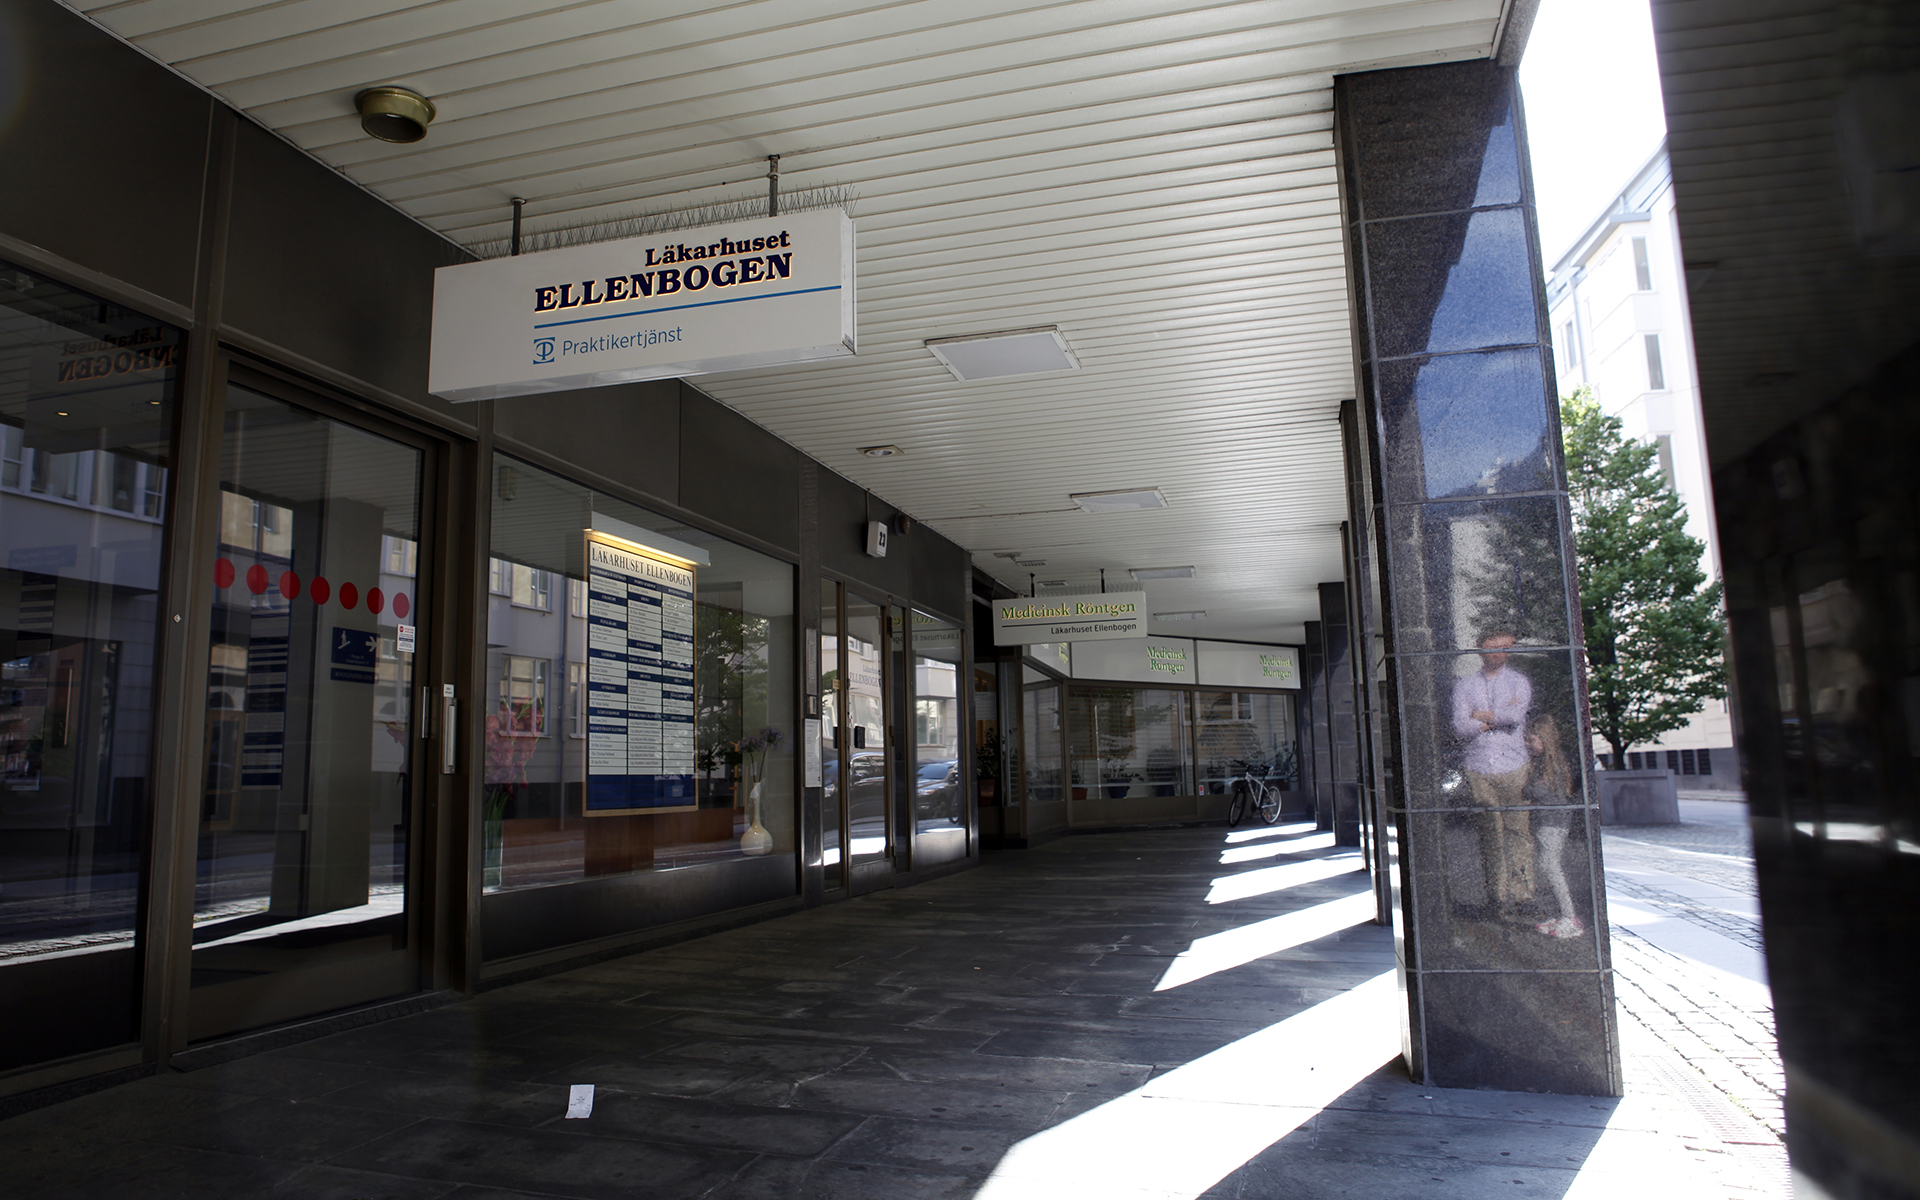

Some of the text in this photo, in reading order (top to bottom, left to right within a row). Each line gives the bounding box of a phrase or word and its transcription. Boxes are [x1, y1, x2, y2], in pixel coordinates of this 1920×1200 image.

[645, 229, 791, 267] Läkarhuset
[533, 252, 793, 313] ELLENBOGEN
[562, 325, 683, 356] Praktikertjänst
[879, 531, 886, 547] 23
[592, 546, 692, 587] LÄKARHUSET ELLENBOGEN
[1001, 601, 1136, 621] Medicinsk Röntgen
[1050, 623, 1137, 635] Läkarhuset Ellenbogen
[1146, 646, 1187, 660] Medicinsk
[1259, 654, 1293, 667] Medicinsk
[1150, 659, 1185, 675] Röntgen
[1263, 666, 1292, 681] Röntgen
